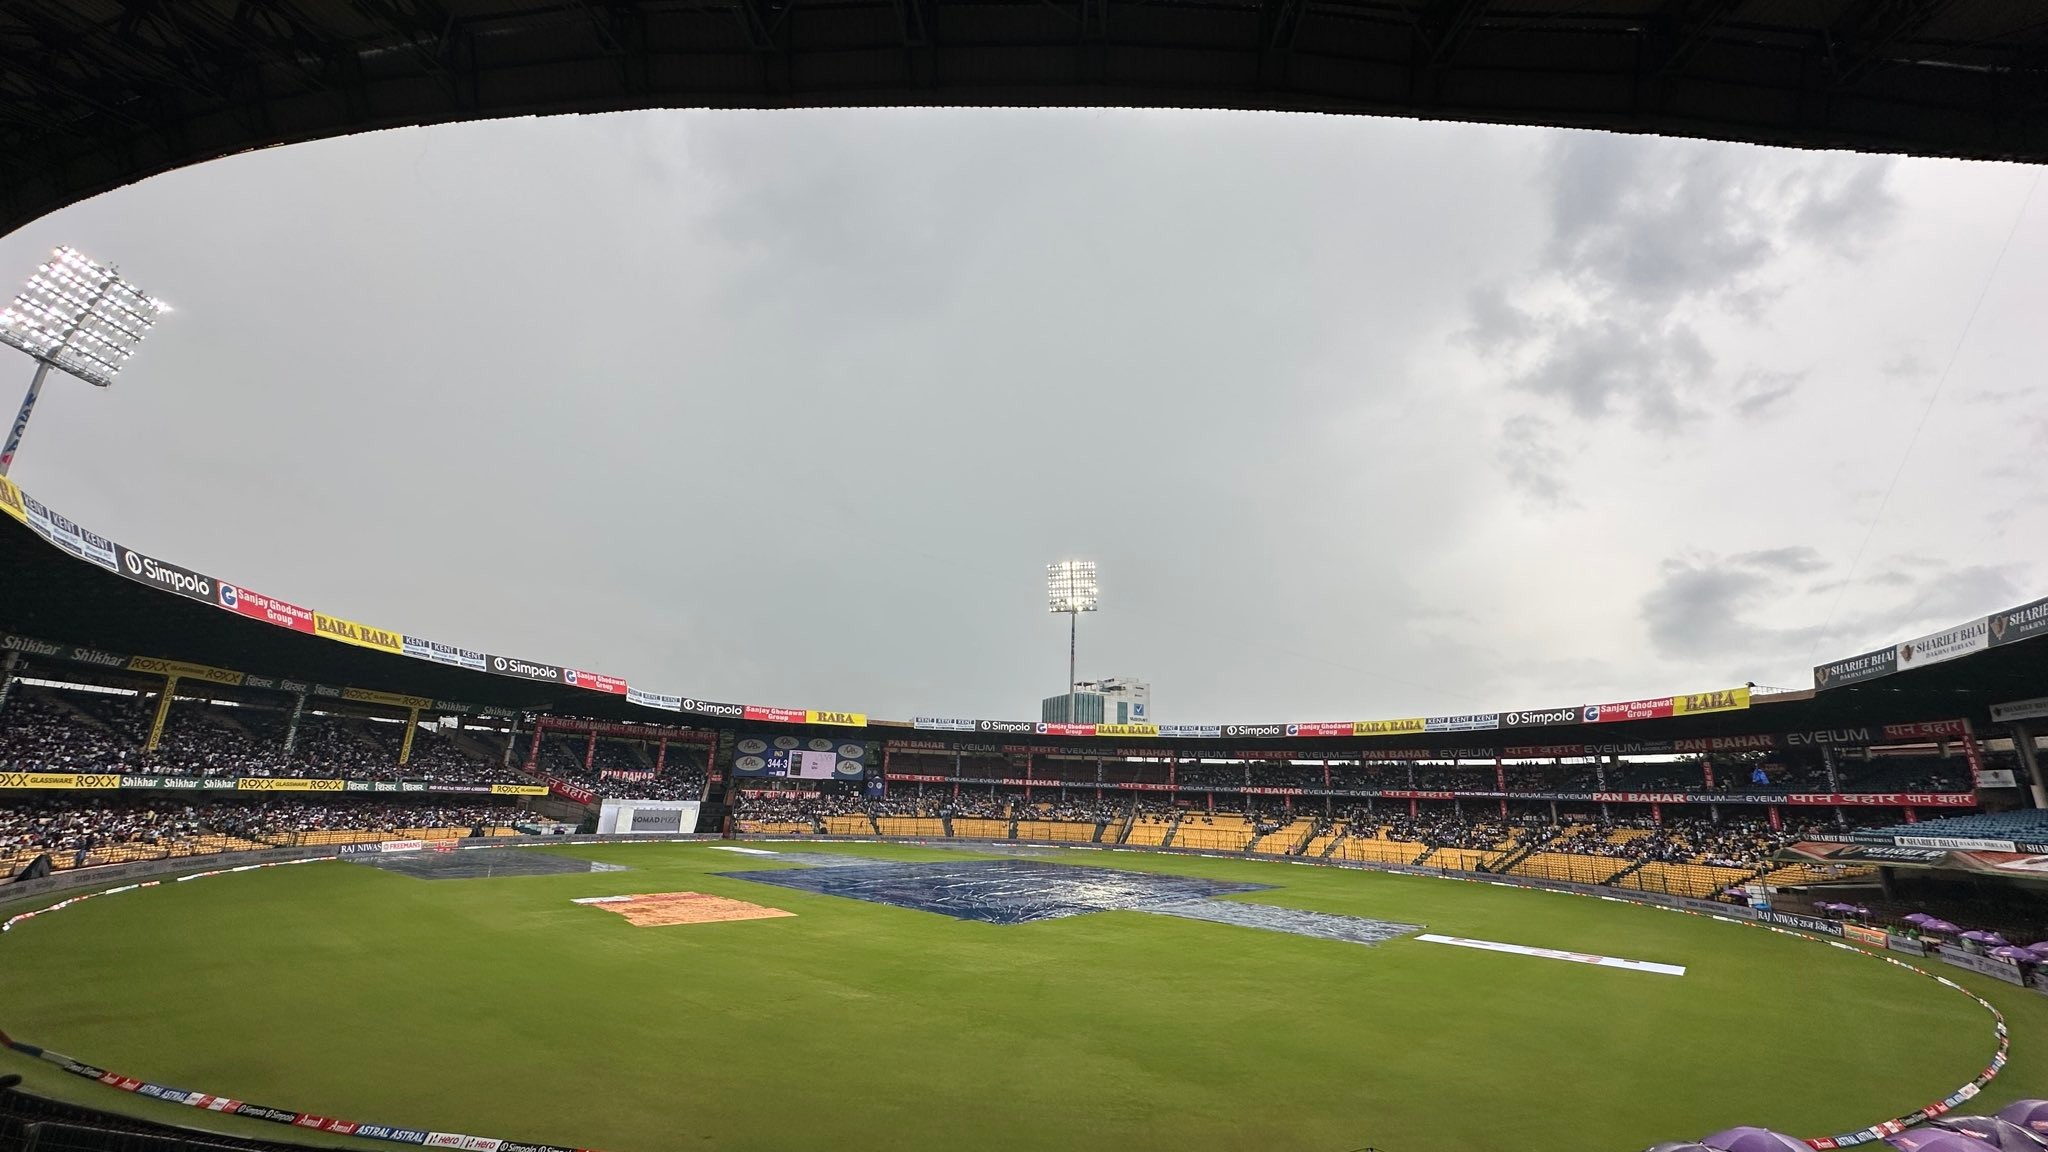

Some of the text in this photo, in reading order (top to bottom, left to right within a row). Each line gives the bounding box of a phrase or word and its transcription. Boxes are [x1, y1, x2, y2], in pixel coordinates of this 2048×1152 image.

[25, 493, 46, 519] KENT
[53, 512, 75, 535] KENT
[85, 530, 108, 549] KENT
[143, 556, 210, 596] Simpolo
[238, 589, 313, 620] Sanjay Ghodawat
[267, 609, 293, 626] Group
[405, 636, 425, 648] KENT
[1916, 622, 1988, 654] SHARIEF BHAI
[1, 636, 127, 666] Shikhar Shikhar
[434, 643, 454, 654] KENT
[462, 650, 481, 660] KENT
[509, 659, 557, 679] Simpolo
[1830, 650, 1895, 676] SHARIEF BHAI
[130, 657, 241, 683] ROXX ROXX
[577, 671, 626, 687] Sanjay Ghodawat
[595, 681, 613, 691] Group
[342, 688, 430, 708] ROXX ROXX
[435, 700, 471, 712] Shikhar
[696, 701, 743, 716] Simpolo
[746, 706, 806, 717] Sanjay Ghodawat
[1600, 698, 1674, 714] Sanjay Ghodawat
[768, 714, 789, 722] Group
[1521, 710, 1575, 725] Simpolo
[1627, 709, 1653, 719] Group
[991, 721, 1030, 733] Simpolo
[1048, 723, 1068, 731] Sanjay
[1238, 725, 1279, 737] Simpolo
[1299, 722, 1352, 731] Sanjay Ghodawat
[1674, 734, 1772, 750] PAN BAHAR
[1786, 727, 1870, 746] EVEIUM
[888, 739, 945, 749] PAN BAHAR
[952, 742, 996, 751] EVEIUM
[1583, 743, 1642, 754] EVEIUM
[1059, 747, 1097, 755] EVEIUM
[1117, 748, 1175, 757] PAN BAHAR
[1181, 750, 1227, 758] EVEIUM
[1298, 751, 1340, 759] EVEIUM
[1362, 750, 1385, 759] PAN
[1389, 750, 1431, 759] BAHAR
[1439, 748, 1494, 759] EVEIUM
[767, 758, 788, 769] 344-3
[30, 775, 117, 788] GLASSWARE ROXX
[121, 775, 236, 790] Shikhar Shikhar Shikhar
[240, 779, 342, 790] ROXX ROXX
[1003, 778, 1061, 787] PAN BAHAR
[496, 785, 521, 794] ROXX
[1240, 786, 1303, 795] PAN BAHAR
[1592, 792, 1686, 802] PAN BAHAR
[1687, 794, 1726, 802] EVEIUM
[1745, 794, 1788, 803] EVEIUM
[632, 815, 660, 824] NOMAD
[1810, 834, 1838, 843] SHARIEF
[1906, 837, 1959, 848] SHARIEF BHAI
[341, 843, 382, 855] RAJ NIWAS
[389, 841, 421, 850] FREEMANS
[1757, 910, 1799, 926] RAJ NIWAS
[242, 1106, 295, 1122] Simpolo Simpolo
[298, 1113, 354, 1134] Amul Amul
[357, 1124, 426, 1143] ASTRAL ASTRAL
[438, 1135, 496, 1150] Hero Hero
